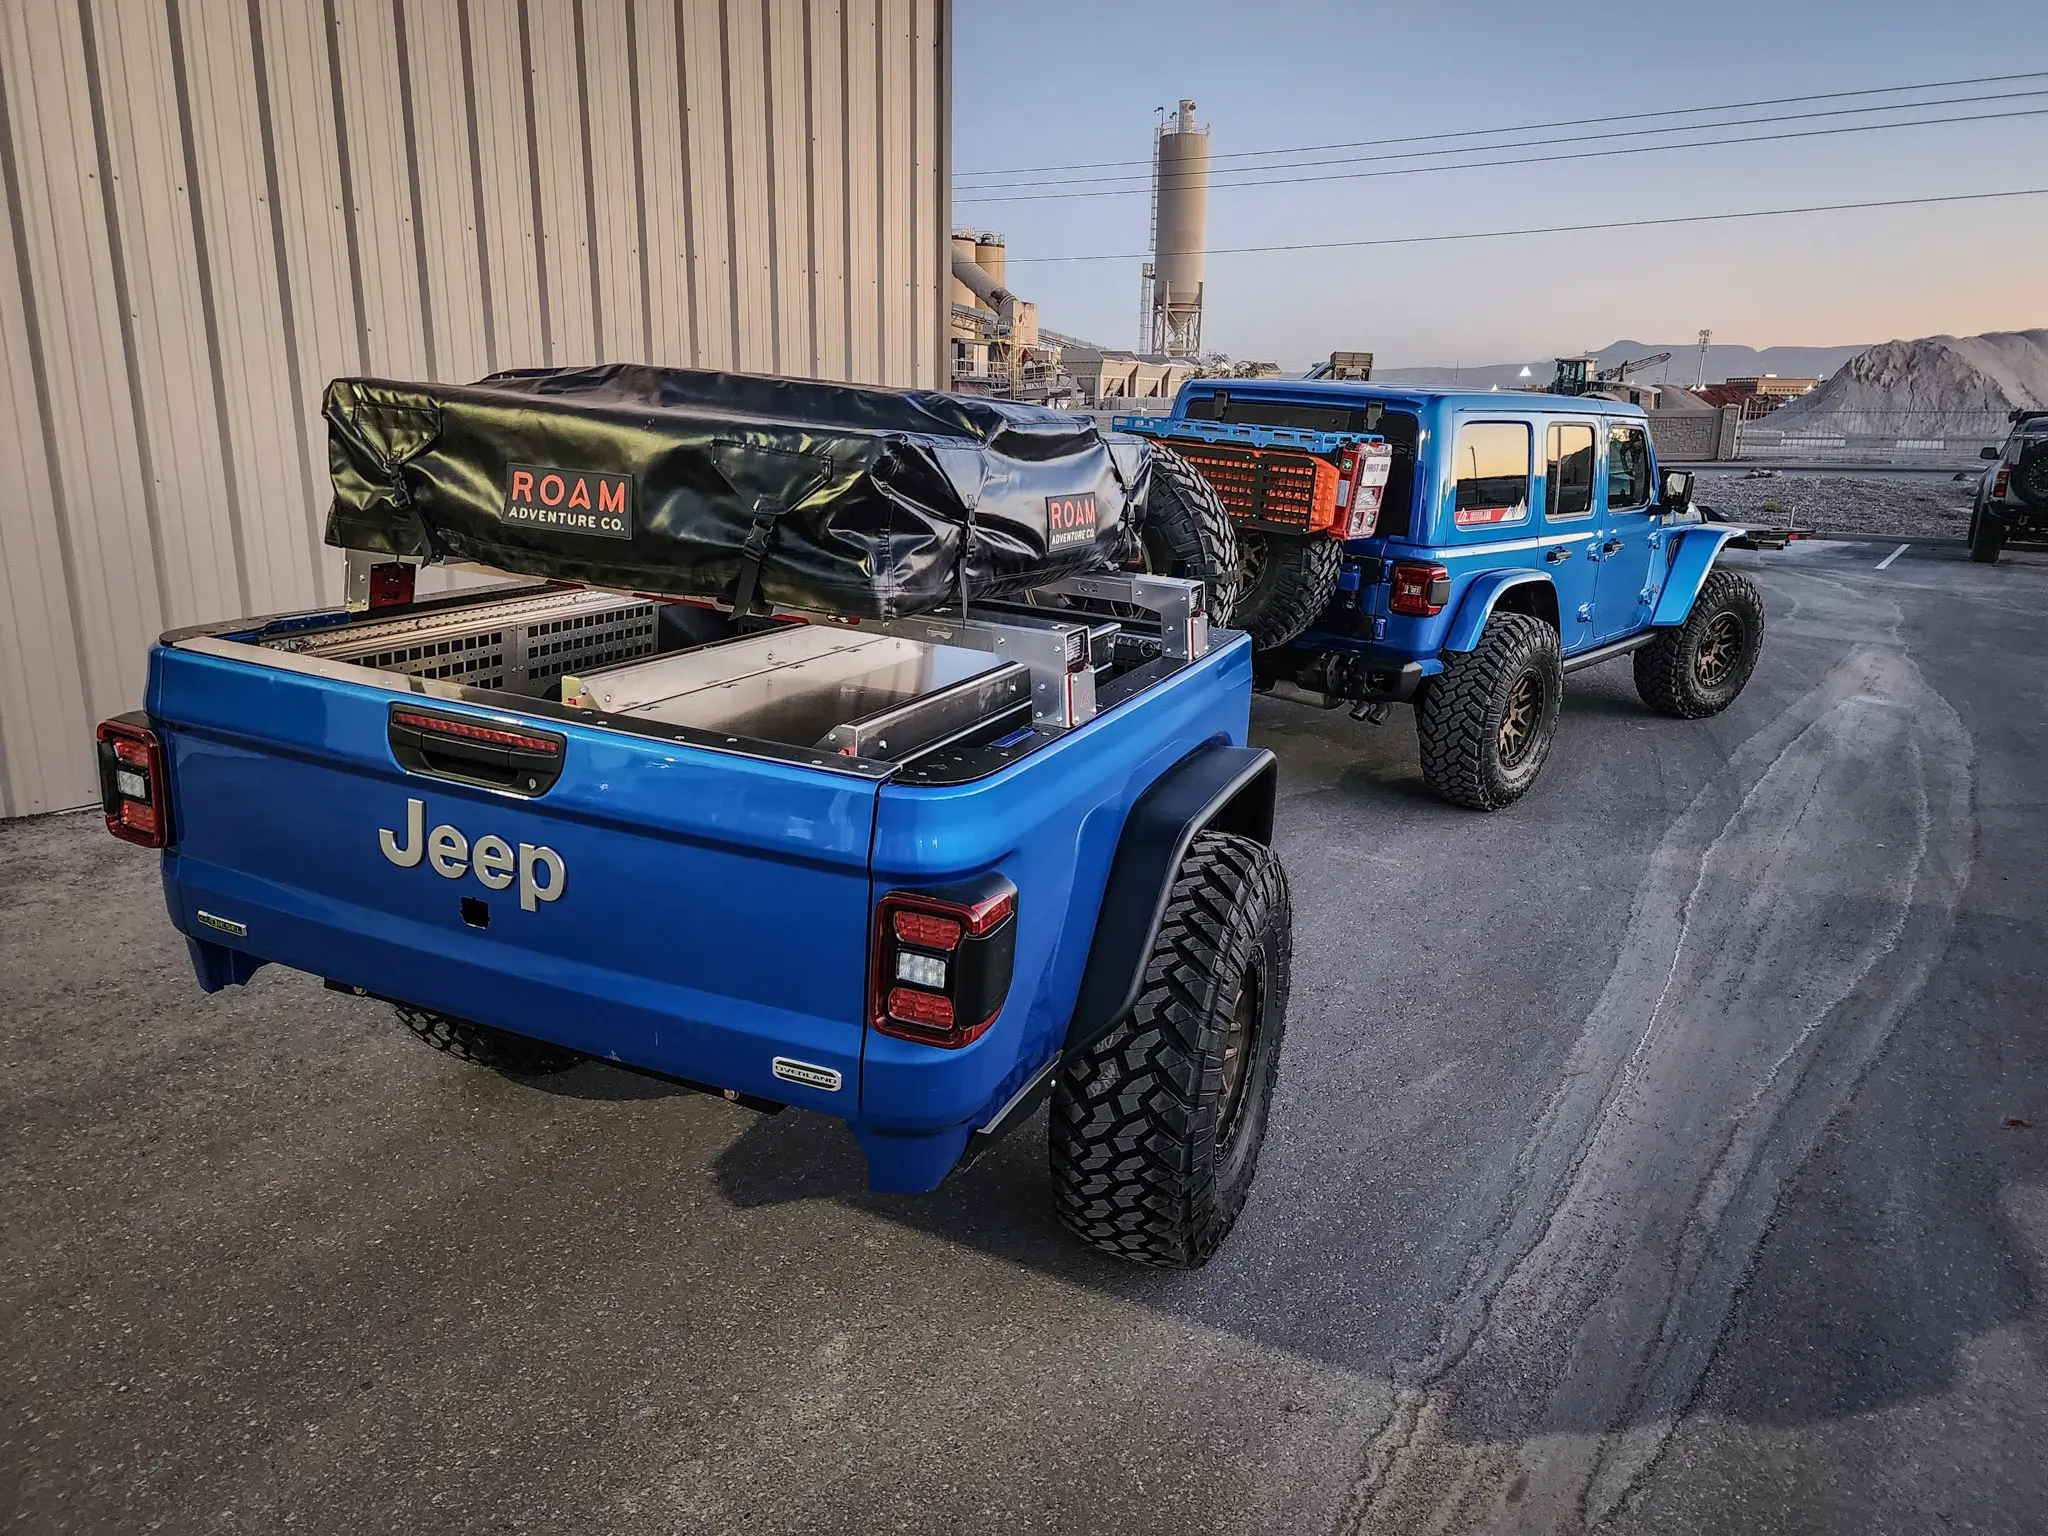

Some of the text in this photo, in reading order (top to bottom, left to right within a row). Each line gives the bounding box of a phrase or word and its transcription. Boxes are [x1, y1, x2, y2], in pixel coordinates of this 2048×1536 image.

[1365, 464, 1380, 472] FIRST
[511, 470, 626, 514] ROAM
[508, 506, 626, 532] ADVENTURE CO.
[1050, 497, 1096, 530] ROAM
[1051, 529, 1087, 546] ADVENTURE
[379, 797, 567, 913] Jeep
[775, 1065, 838, 1085] OVERLAND
